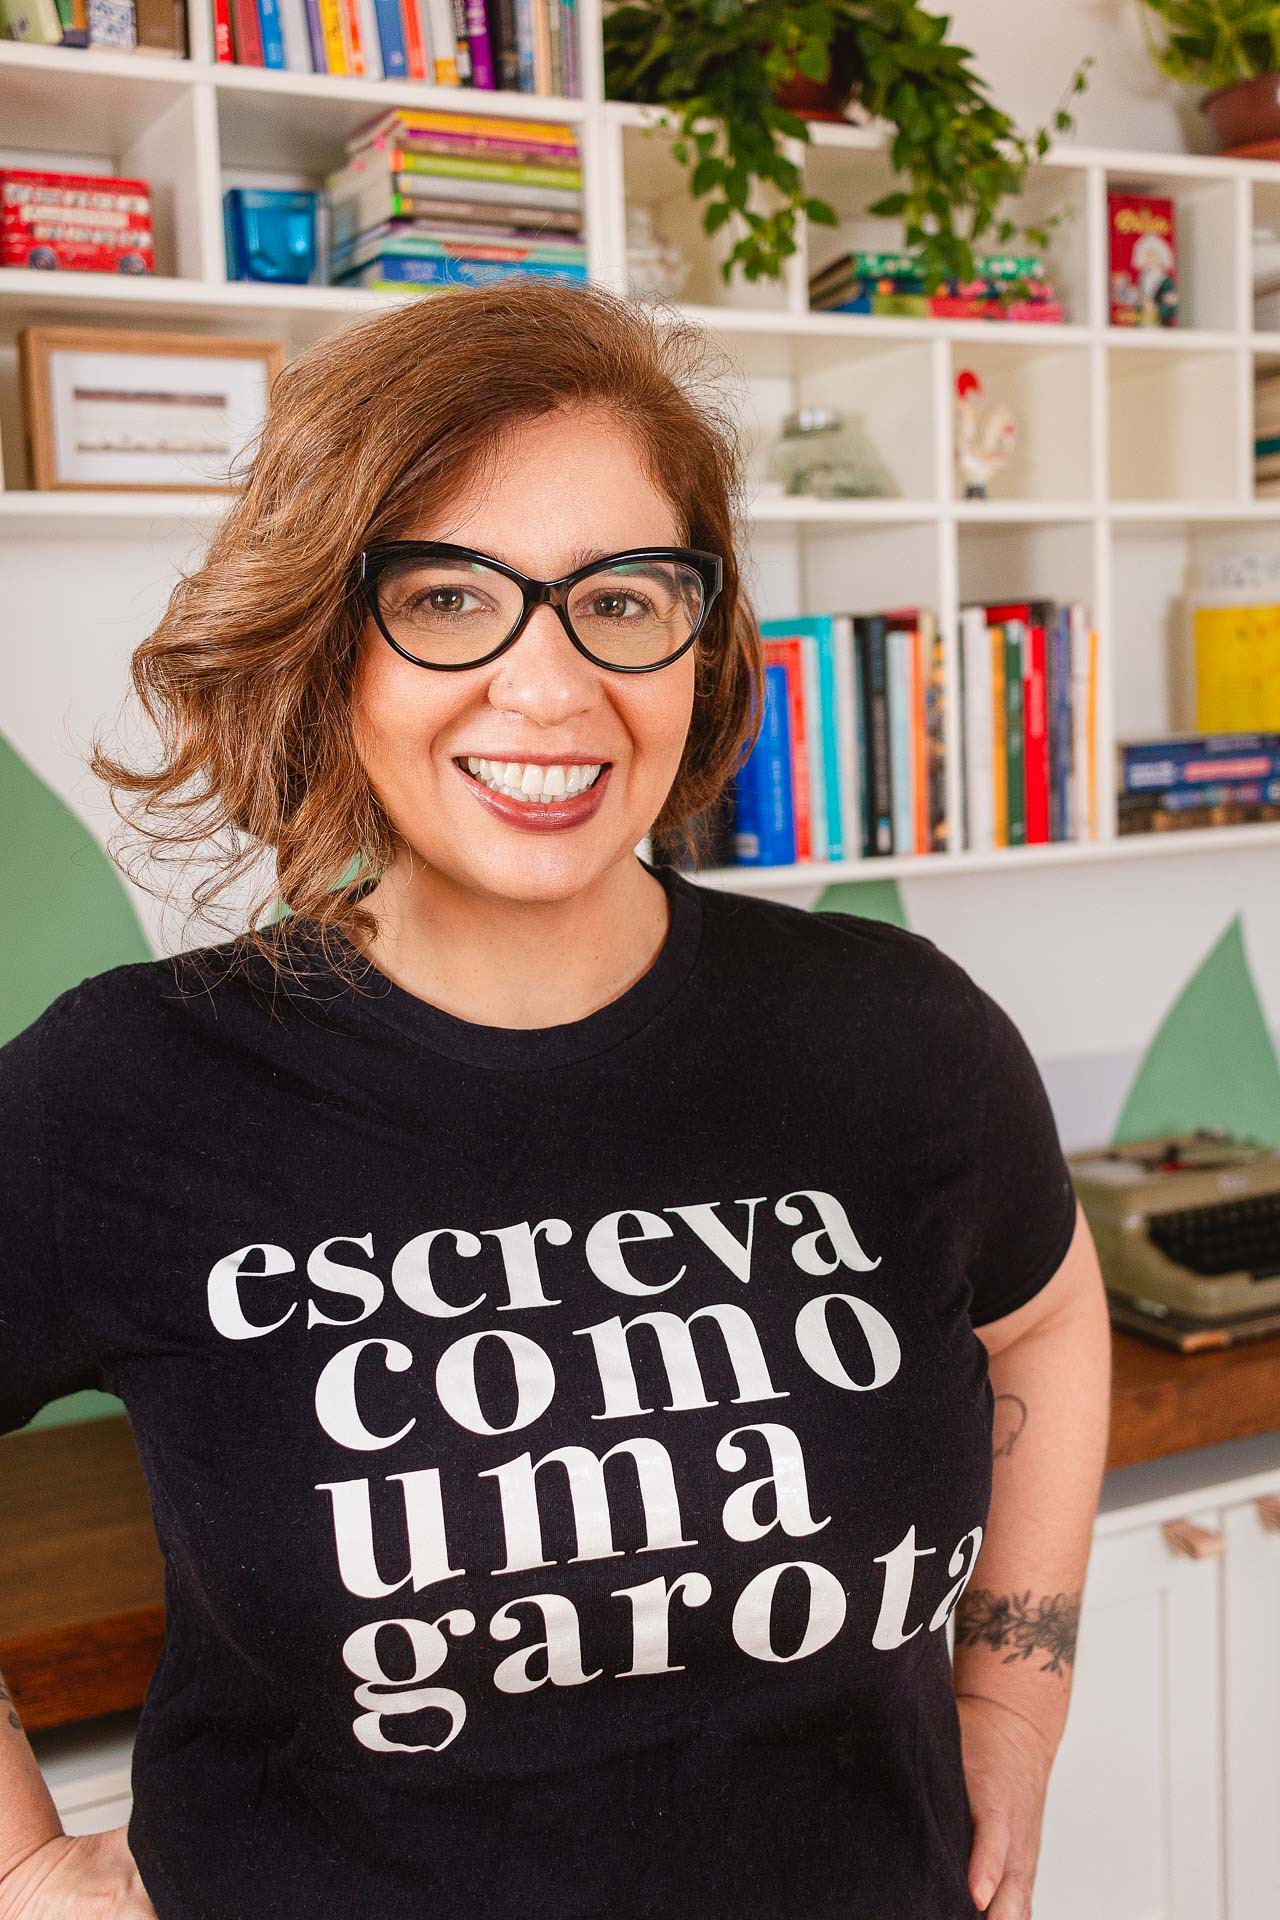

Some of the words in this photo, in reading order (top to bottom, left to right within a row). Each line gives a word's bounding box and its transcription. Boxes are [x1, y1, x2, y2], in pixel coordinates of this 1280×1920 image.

[206, 1189, 882, 1341] escreva
[315, 1293, 901, 1451] como
[315, 1423, 831, 1599] uma
[341, 1525, 983, 1752] garota
